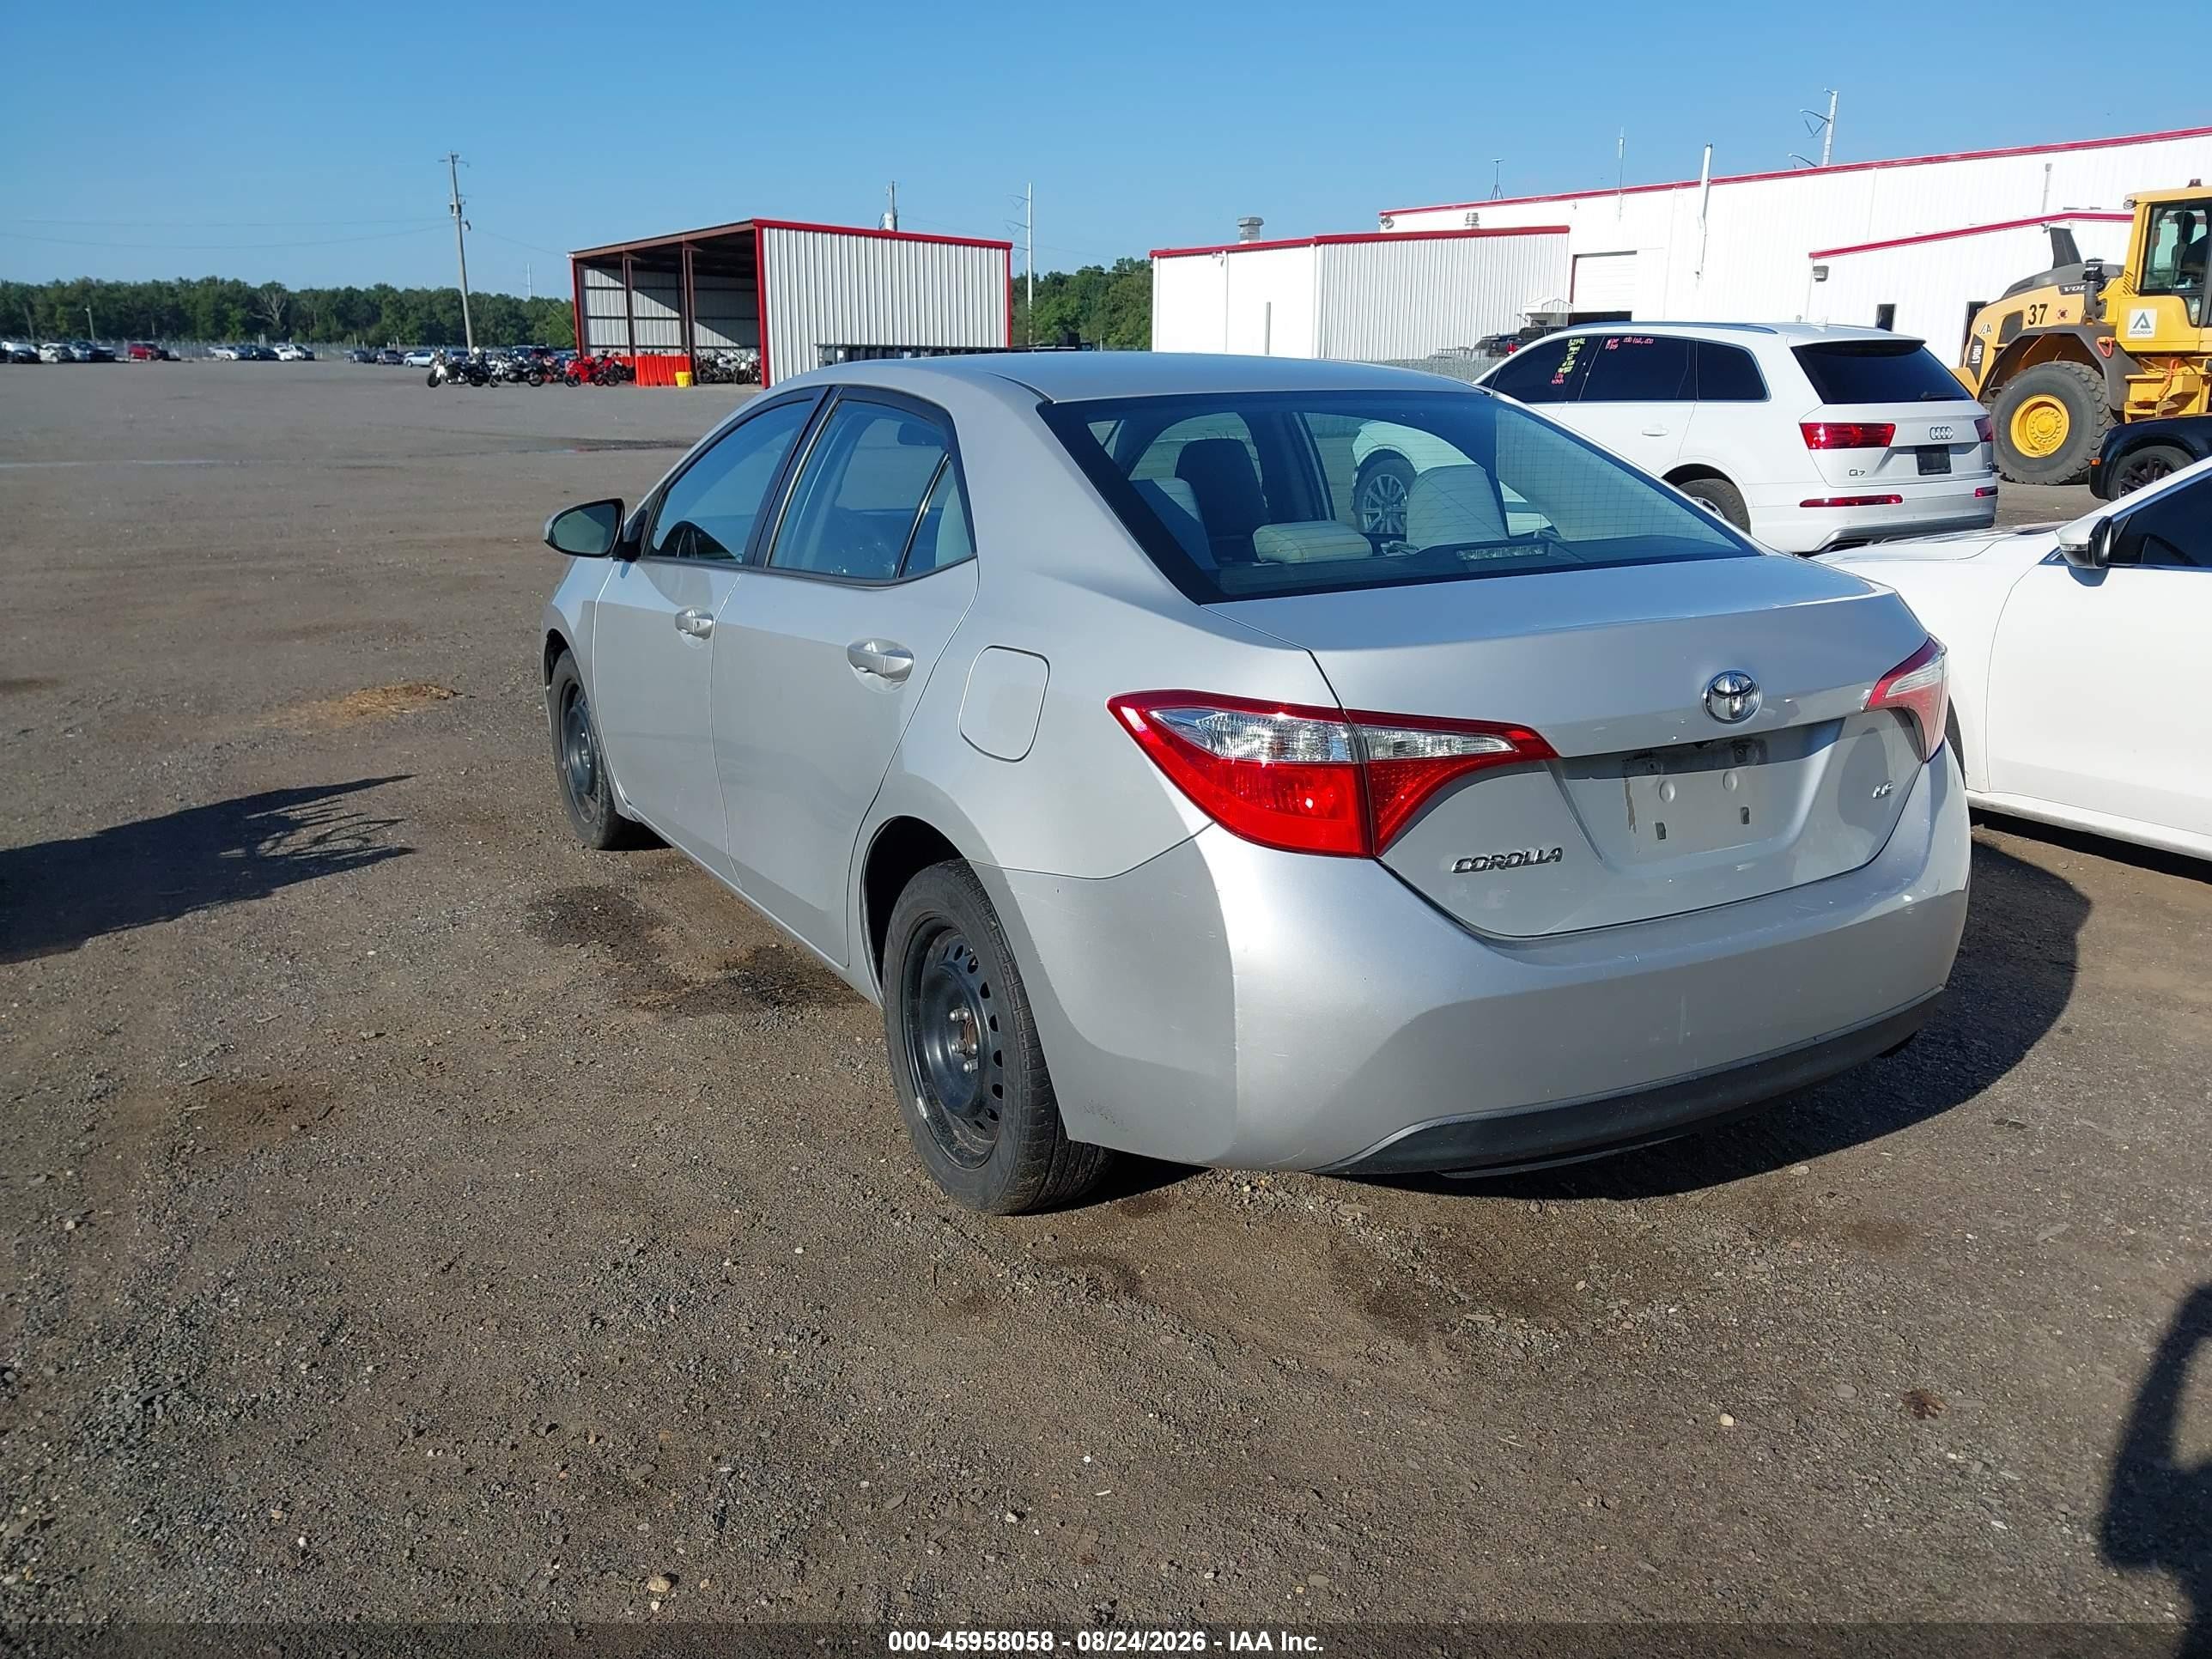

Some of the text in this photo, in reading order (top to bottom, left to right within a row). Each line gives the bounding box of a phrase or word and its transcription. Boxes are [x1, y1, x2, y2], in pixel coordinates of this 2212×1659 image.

[2027, 303, 2048, 325] 37
[1971, 344, 1983, 364] L90H
[1451, 847, 1563, 873] COROLLA
